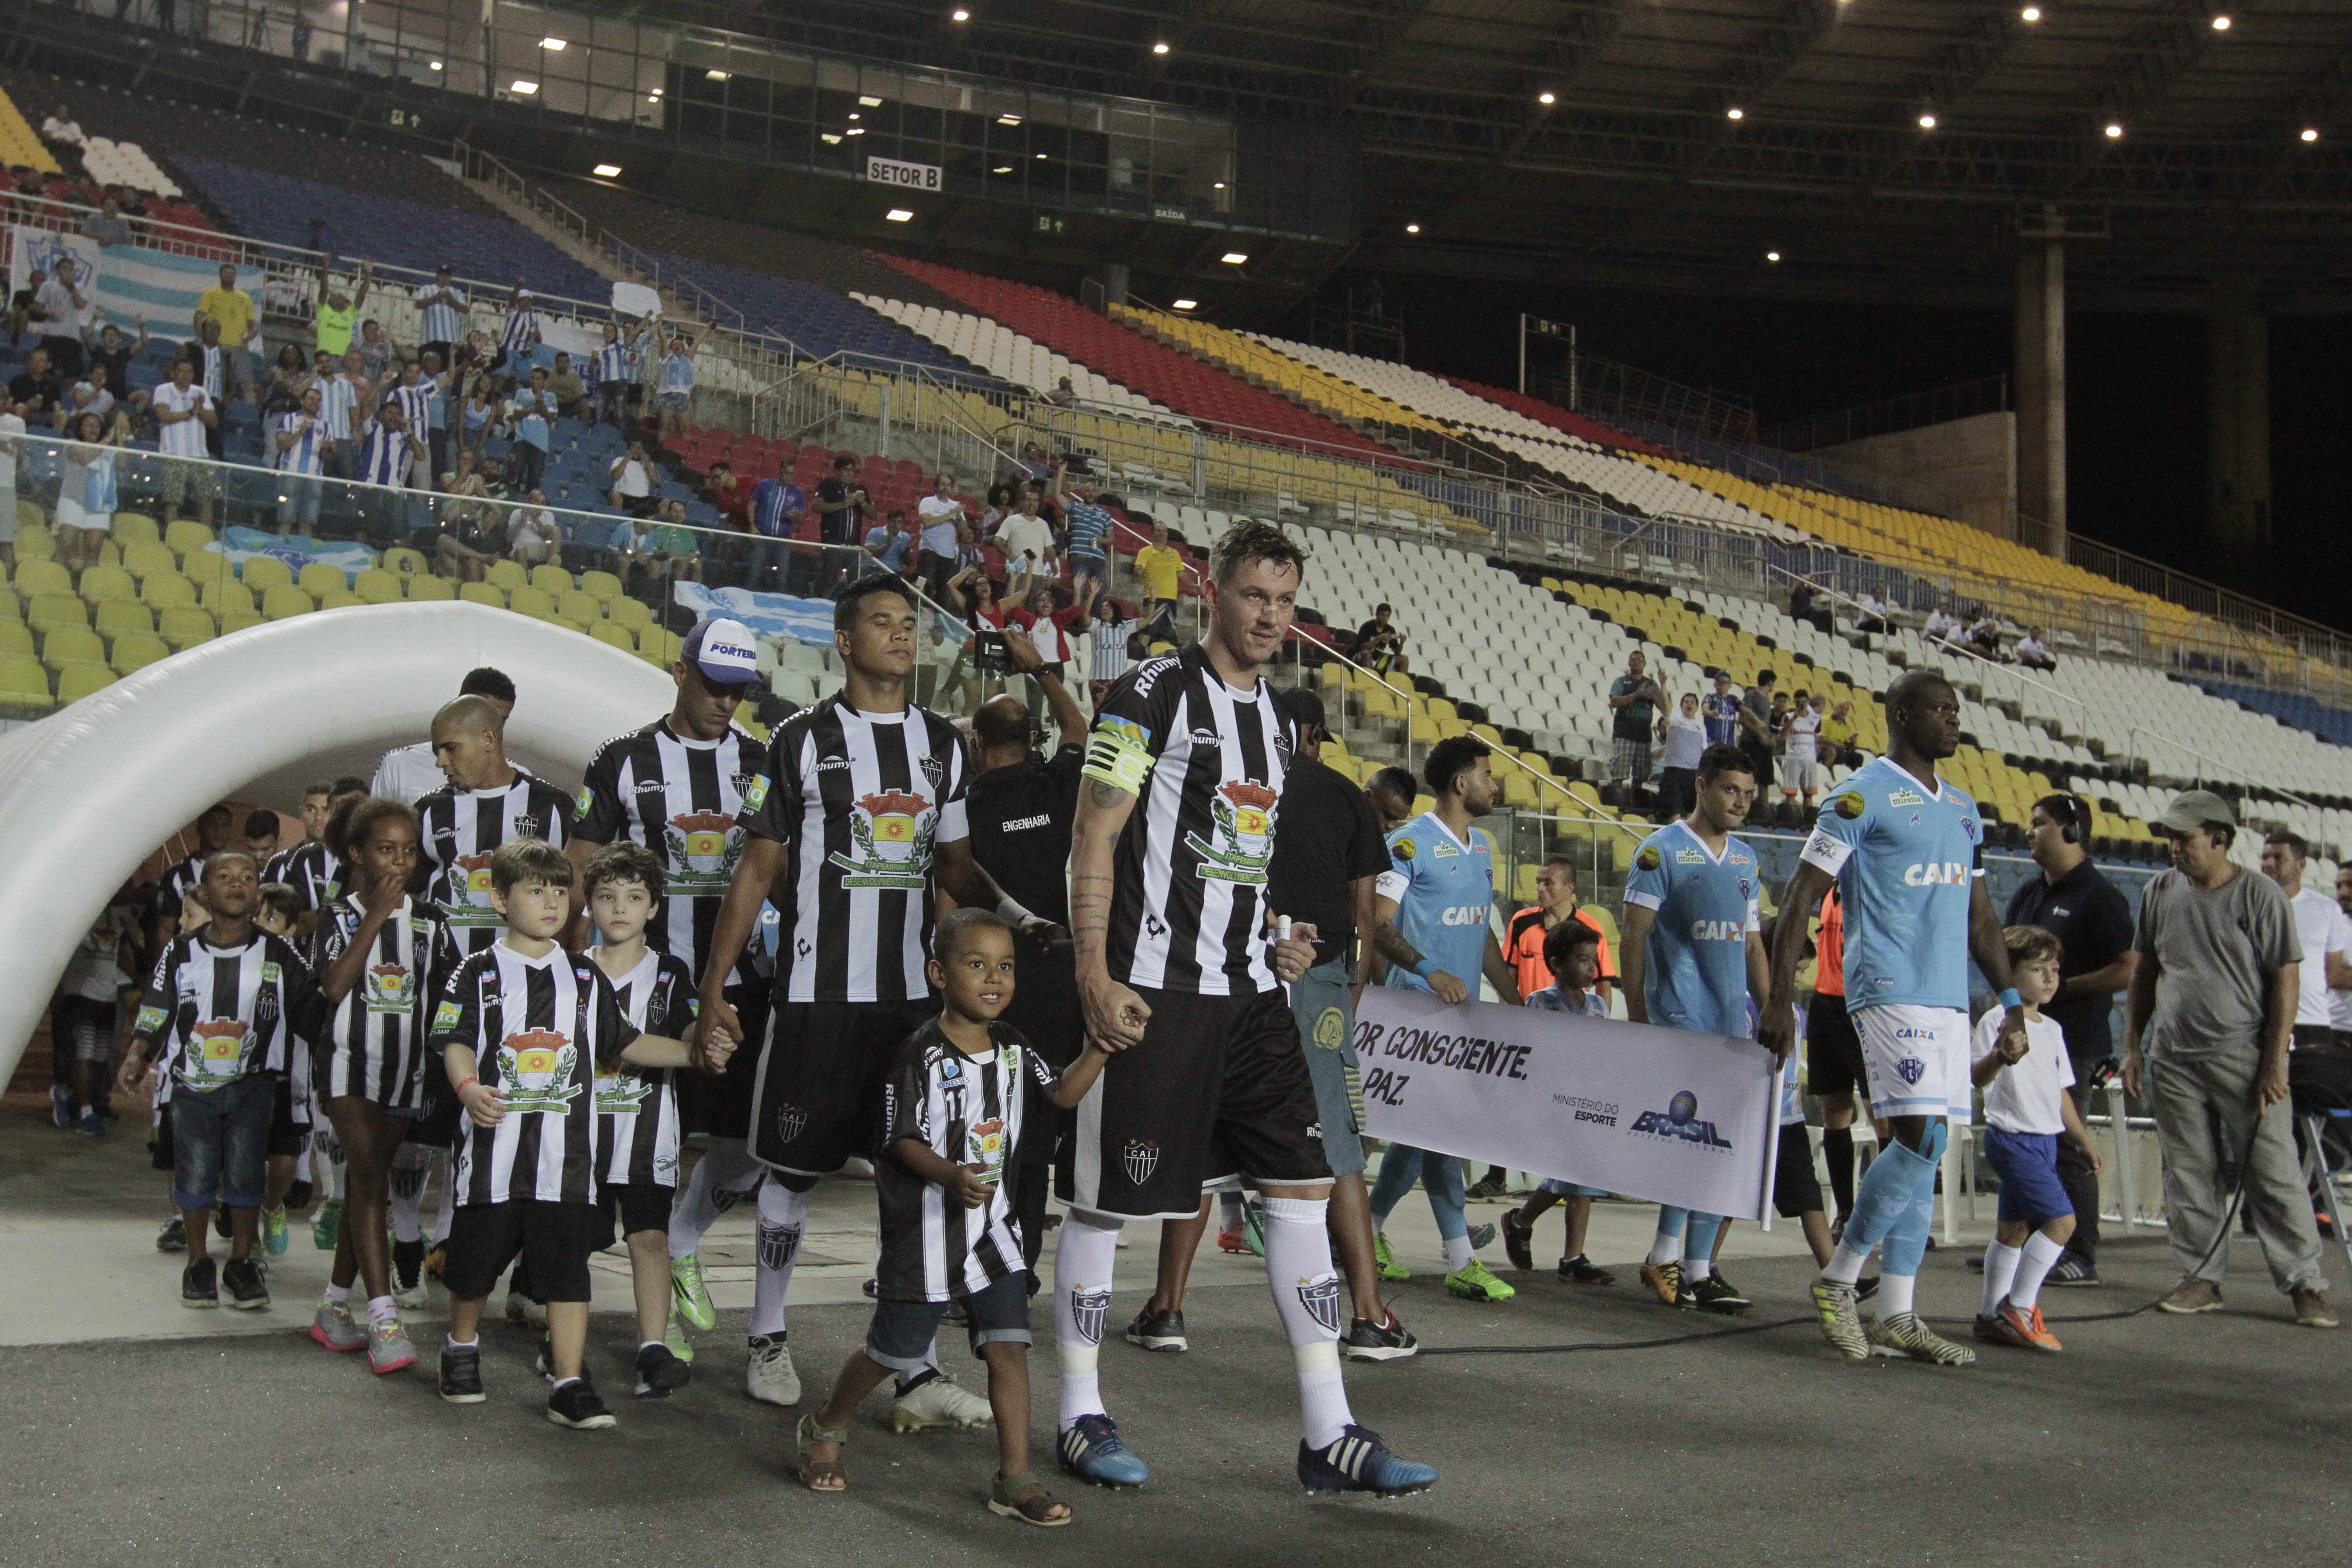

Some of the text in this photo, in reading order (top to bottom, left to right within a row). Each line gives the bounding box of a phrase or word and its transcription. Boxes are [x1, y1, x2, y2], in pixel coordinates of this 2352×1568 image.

[871, 162, 937, 187] SETOR B
[1155, 209, 1185, 220] SAÍDA
[1134, 656, 1182, 698] Rhumy
[1187, 733, 1221, 747] Rhumy
[812, 760, 852, 774] Rhumy
[924, 761, 937, 769] CAI
[630, 784, 666, 795] Rhumy
[1892, 795, 1921, 805] mirella
[1002, 813, 1051, 832] ENGENHARIA
[1225, 852, 1259, 866] ITAPEMIRIM
[866, 862, 905, 871] ITAPEMIRIM
[1905, 862, 1968, 886] CAIX
[1442, 906, 1488, 926] CAIX
[1691, 920, 1747, 941] CAIX
[1896, 1028, 1934, 1040] CAIXA
[937, 1076, 970, 1089] BANESTES
[1362, 1068, 1410, 1106] PAZ.
[946, 1089, 965, 1121] 11
[1552, 1093, 1619, 1114] MINISTÉRIO DO
[783, 1112, 799, 1122] CAI
[1575, 1110, 1617, 1127] ESPORTE
[1630, 1111, 1733, 1149] BRASIL
[1131, 1150, 1151, 1158] CAI
[1681, 1140, 1734, 1156] FEDERAL
[766, 1232, 794, 1242] CAI
